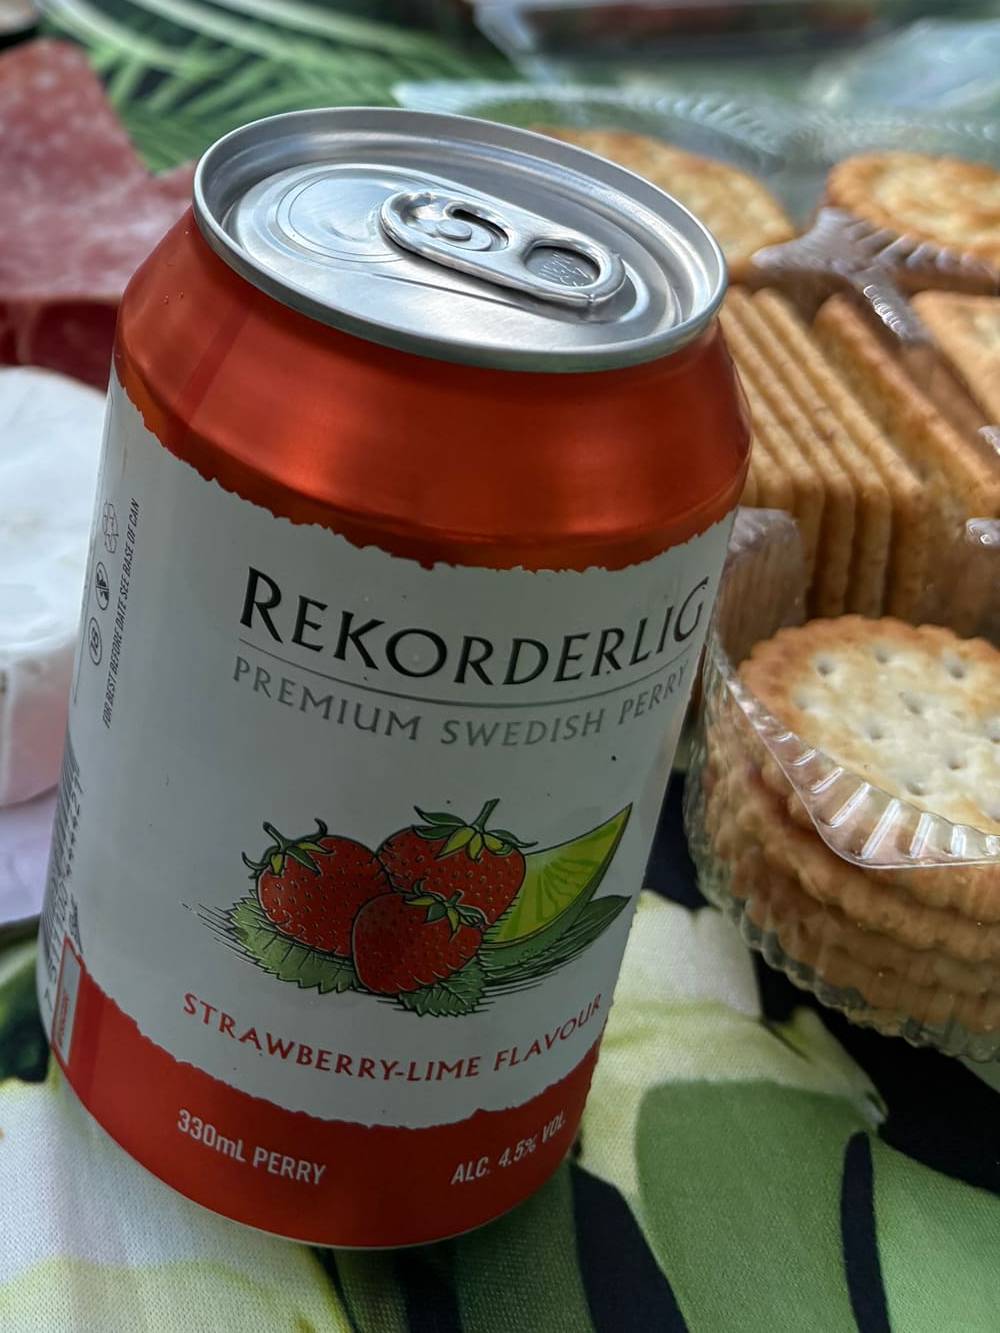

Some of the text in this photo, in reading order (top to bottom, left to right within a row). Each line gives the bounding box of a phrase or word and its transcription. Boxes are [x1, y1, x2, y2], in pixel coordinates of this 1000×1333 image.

[102, 497, 140, 729] FOR BEST BEFORE DATE SEE BASE OF CAN
[238, 566, 709, 686] REKORDERLIG
[232, 655, 692, 747] PREMIUM SWEDISH PERRY
[182, 992, 602, 1082] STRAWBERRY-LIME FLAVOUR
[177, 1108, 327, 1185] 330mL PERRY
[450, 1155, 491, 1186] ALC.
[497, 1133, 538, 1168] 4.5%
